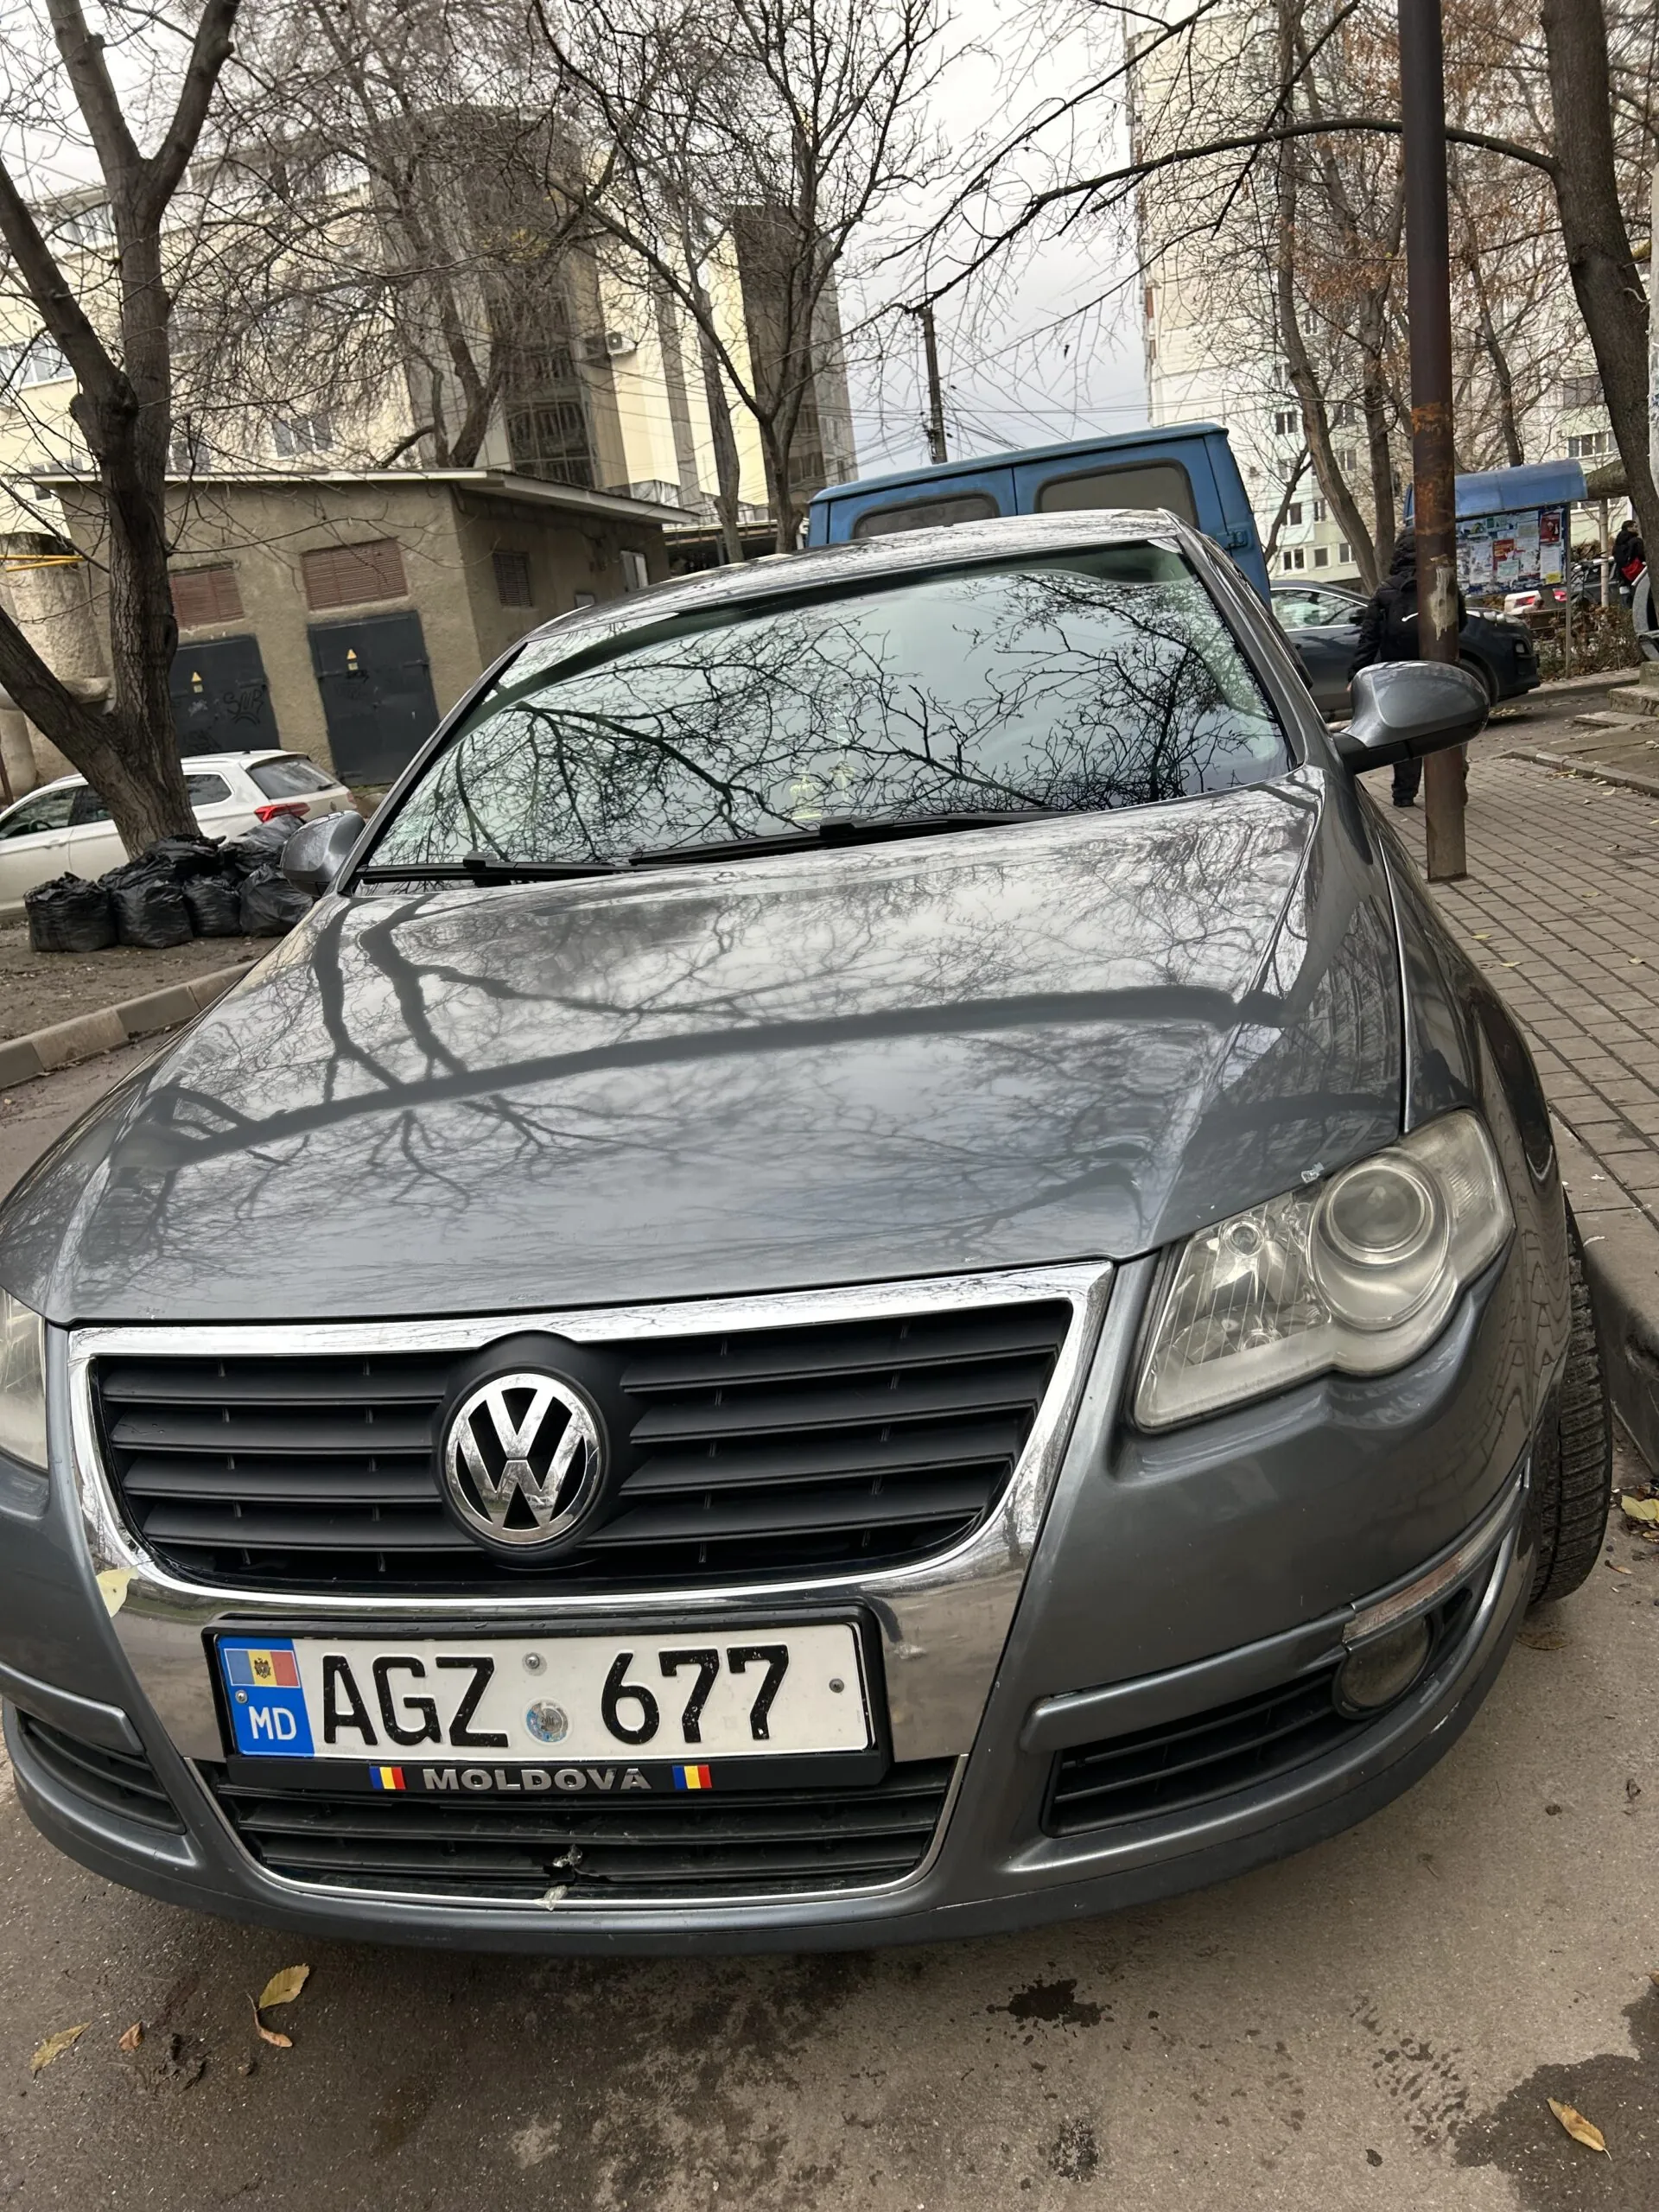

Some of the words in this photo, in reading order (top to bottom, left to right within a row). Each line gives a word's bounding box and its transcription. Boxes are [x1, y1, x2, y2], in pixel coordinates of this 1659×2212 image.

[454, 1379, 588, 1534] VW
[248, 1707, 296, 1740] MD
[322, 1655, 509, 1747] AGZ
[601, 1644, 790, 1745] 677
[422, 1768, 652, 1790] MOLDOVA
